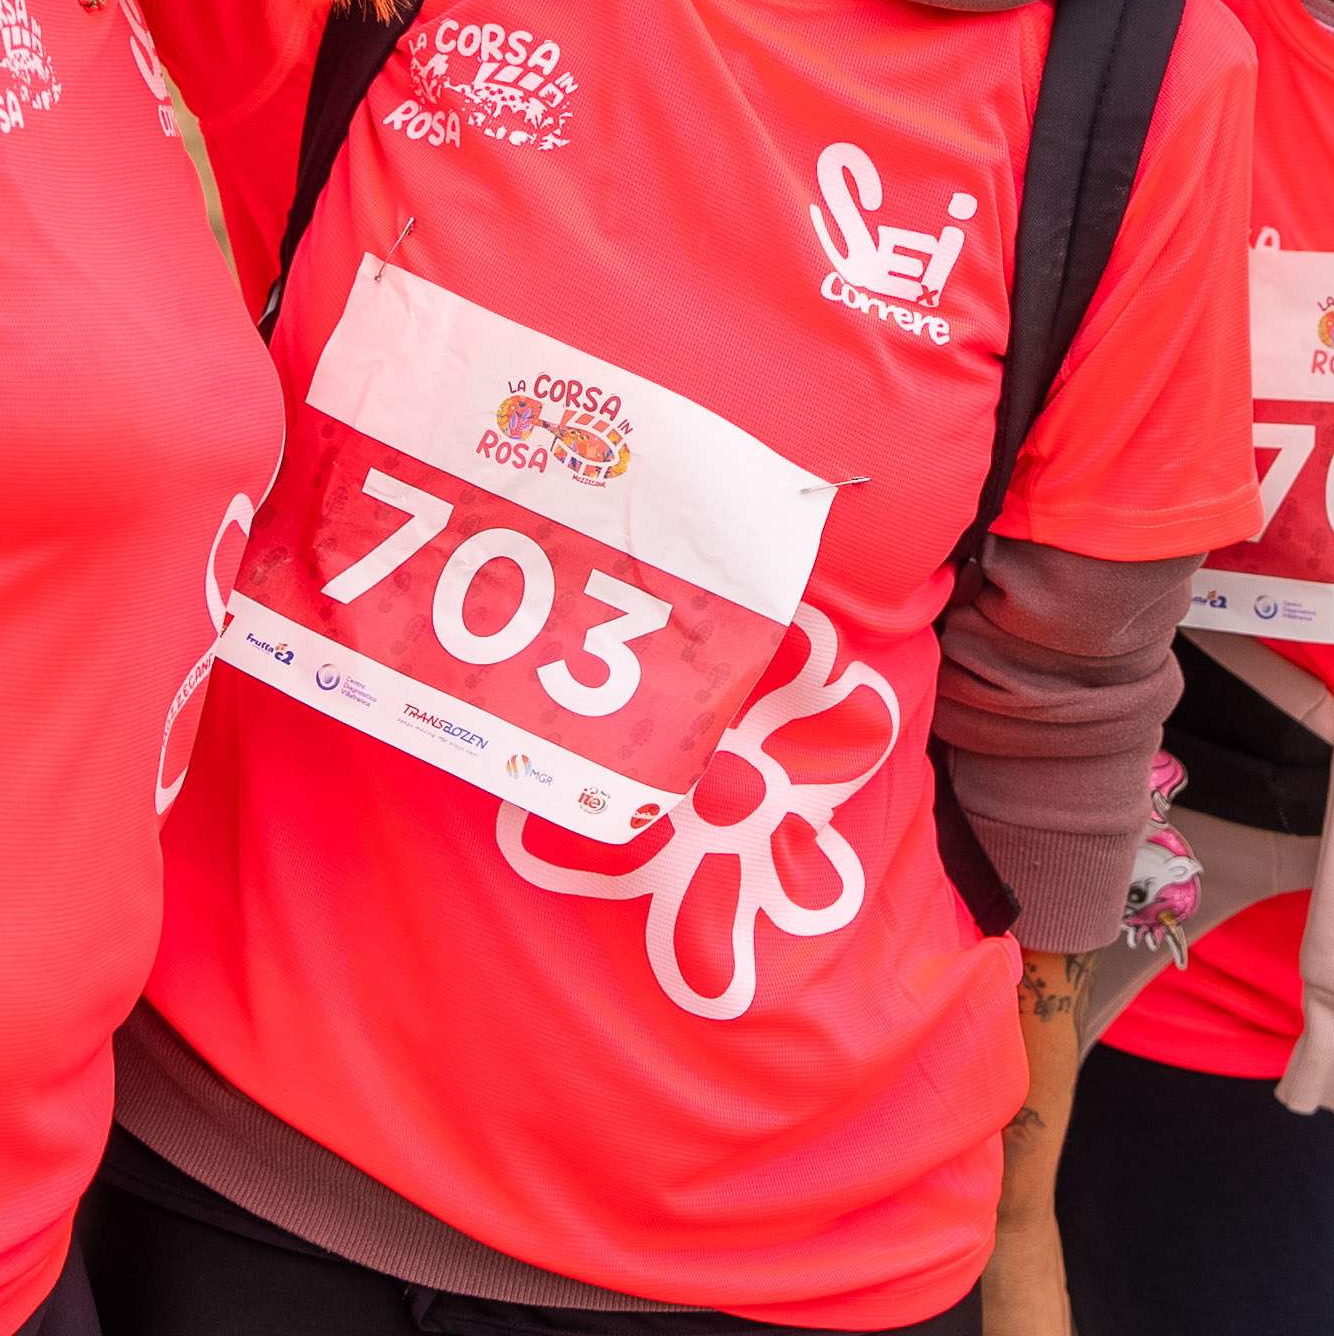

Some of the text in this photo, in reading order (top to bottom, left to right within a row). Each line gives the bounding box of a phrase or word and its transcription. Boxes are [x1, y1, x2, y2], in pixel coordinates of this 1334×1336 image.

[408, 19, 579, 94] LA CORSA IN
[382, 100, 461, 148] ROSA
[508, 374, 633, 435] LA CORSA IN
[476, 429, 548, 473] ROSA
[320, 467, 673, 716] 703
[403, 703, 489, 749] TRANSBOZEN
[529, 769, 553, 786] MGR
